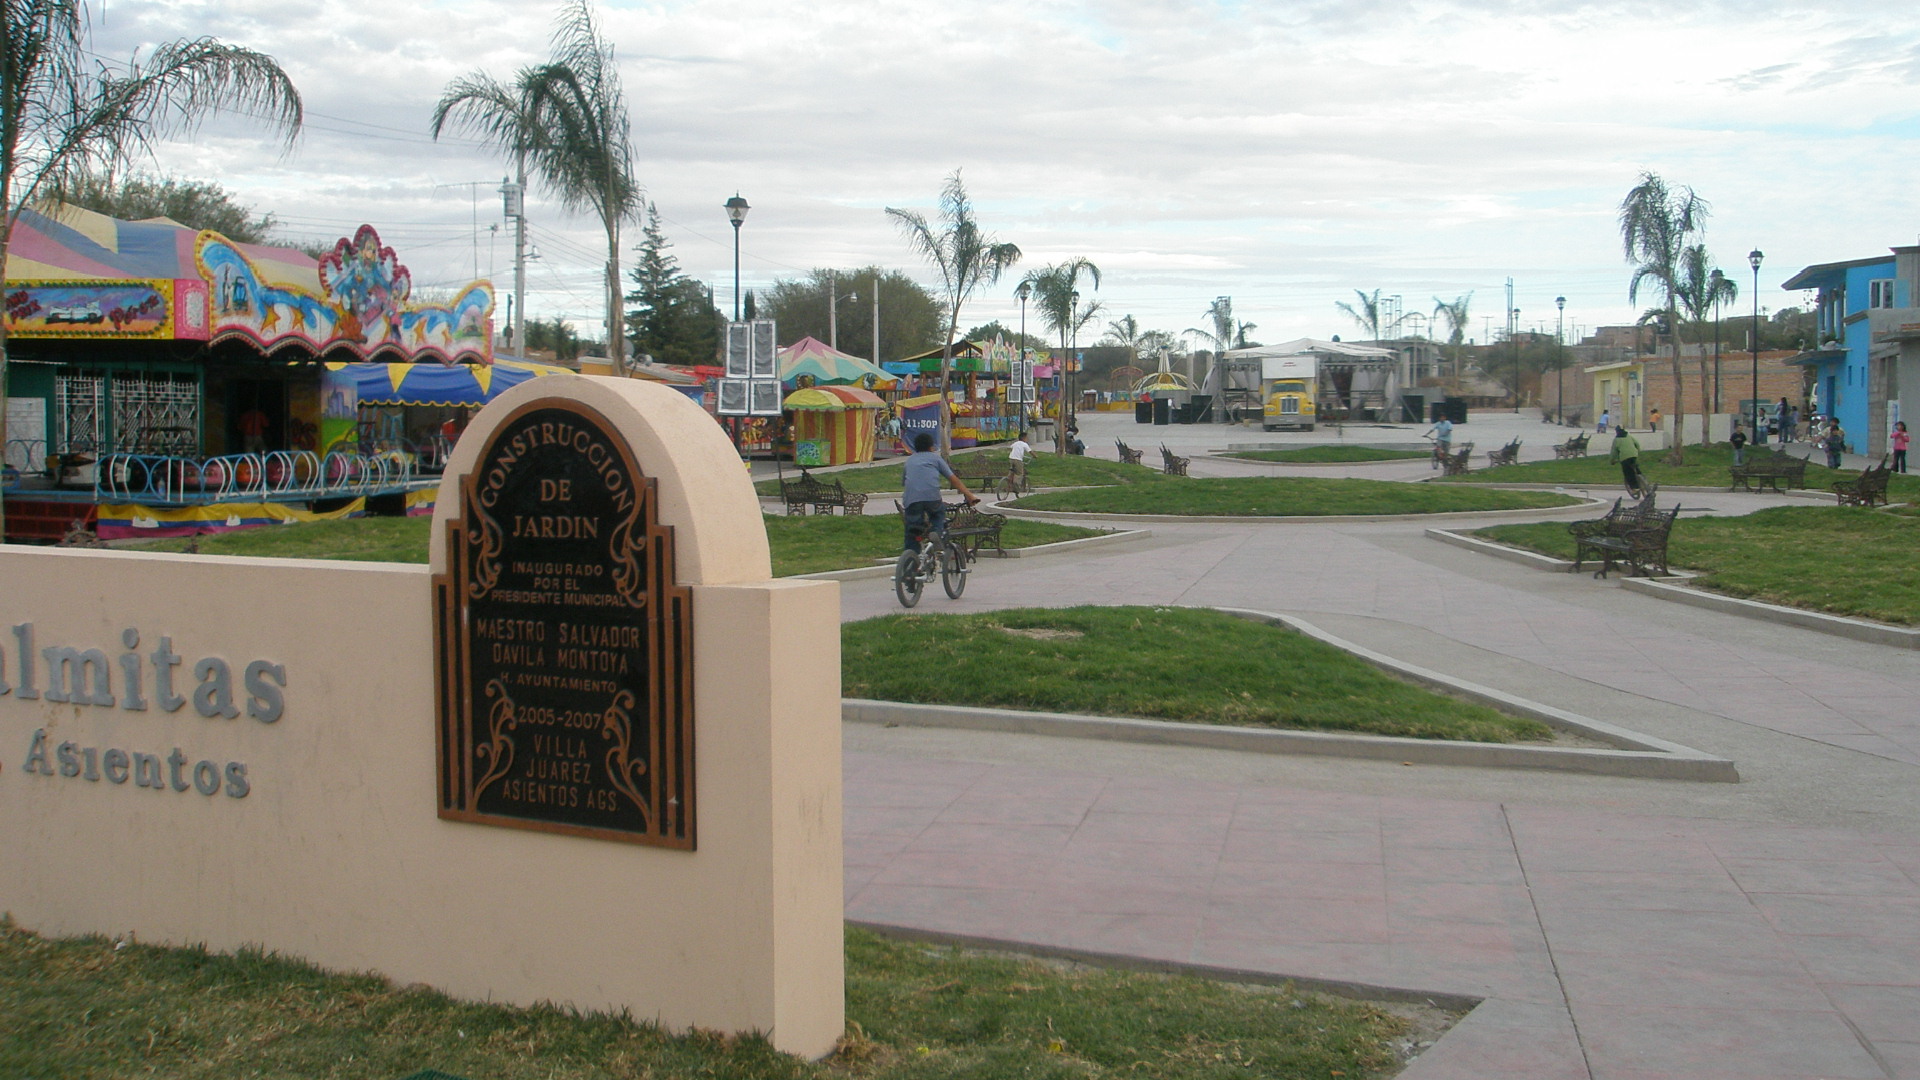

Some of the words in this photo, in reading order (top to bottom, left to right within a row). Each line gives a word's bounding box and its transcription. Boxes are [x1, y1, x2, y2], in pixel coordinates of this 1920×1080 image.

[480, 422, 633, 513] CONSTRUCCION
[540, 479, 572, 502] DE
[512, 515, 599, 539] JARDIN
[512, 561, 604, 577] INAUGURADO
[533, 577, 561, 591] POR
[565, 578, 581, 591] EL
[491, 590, 561, 606] PRESIDENTE
[563, 592, 626, 607] MUNICIPAL
[476, 618, 545, 643] MAESTRO
[559, 622, 640, 649] SALVADOR
[492, 643, 545, 667] DAVILA
[557, 649, 629, 675] MONTOYA
[517, 675, 618, 693] AYUNTAMIENTO
[518, 706, 602, 730] 2005-2007
[533, 735, 588, 759] VILLA
[22, 728, 251, 799] Asientos
[526, 760, 592, 784] JUAREZ
[502, 779, 578, 808] ASIENTOS
